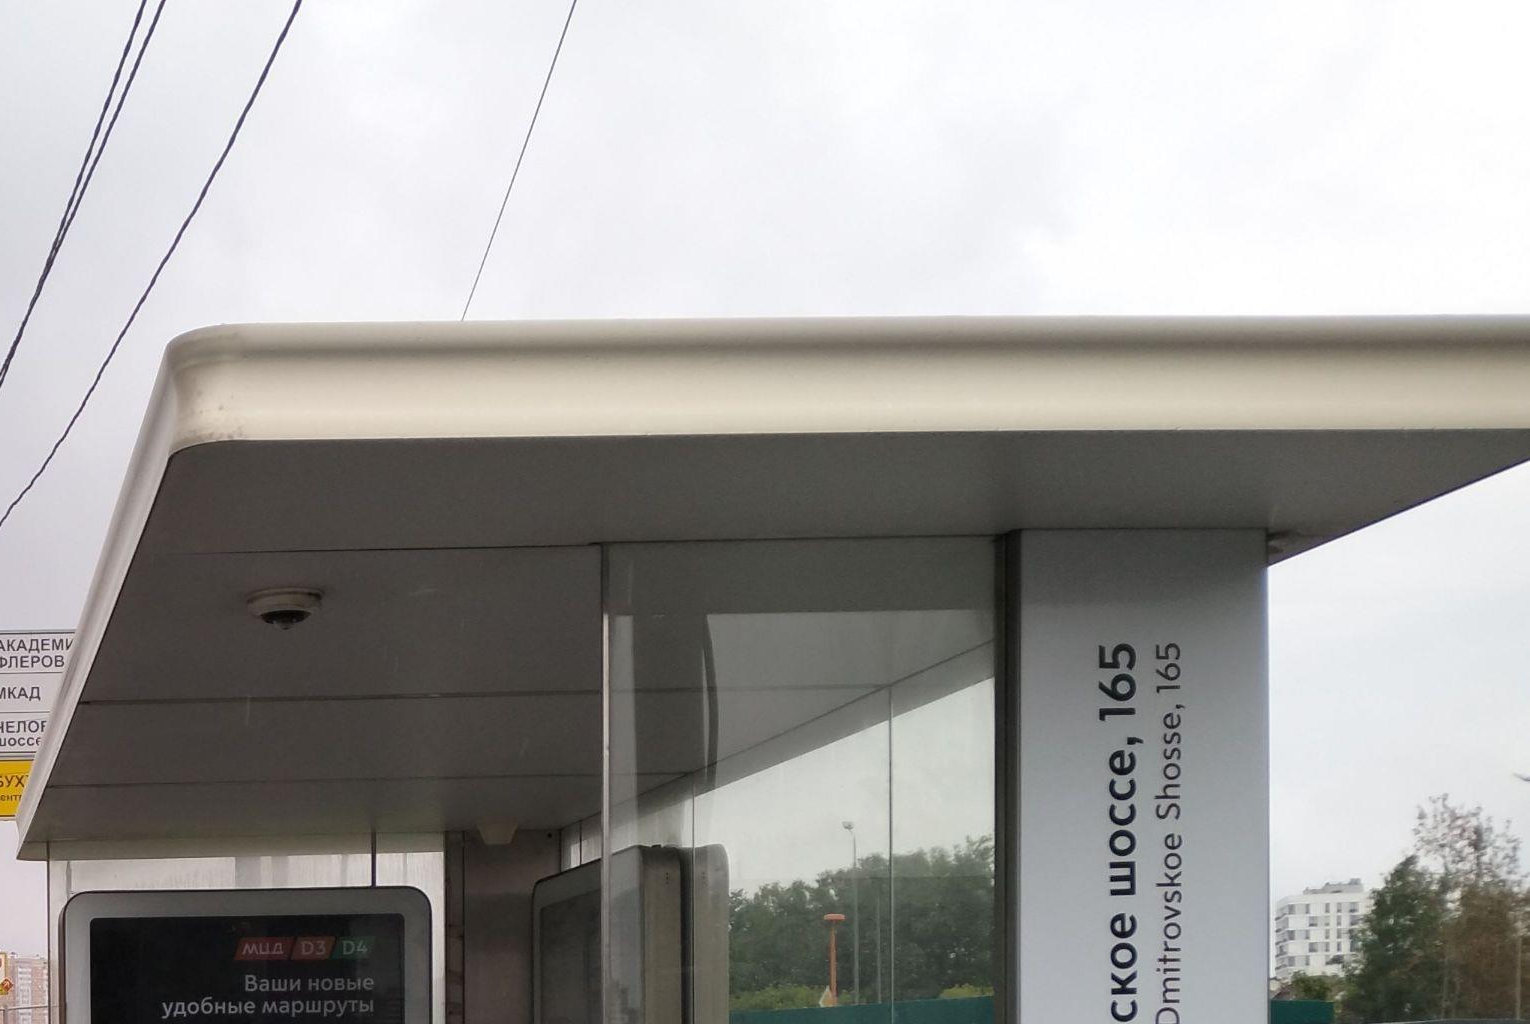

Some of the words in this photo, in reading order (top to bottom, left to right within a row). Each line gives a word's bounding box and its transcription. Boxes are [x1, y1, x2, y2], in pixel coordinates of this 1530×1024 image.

[1098, 643, 1137, 722] 165
[1155, 642, 1181, 693] 165
[1154, 703, 1186, 821] Shosse,
[1108, 736, 1144, 896] шоссе,
[161, 996, 256, 1019] удобные
[262, 998, 375, 1018] маршруты
[244, 974, 301, 991] Ваши
[308, 975, 375, 991] новые
